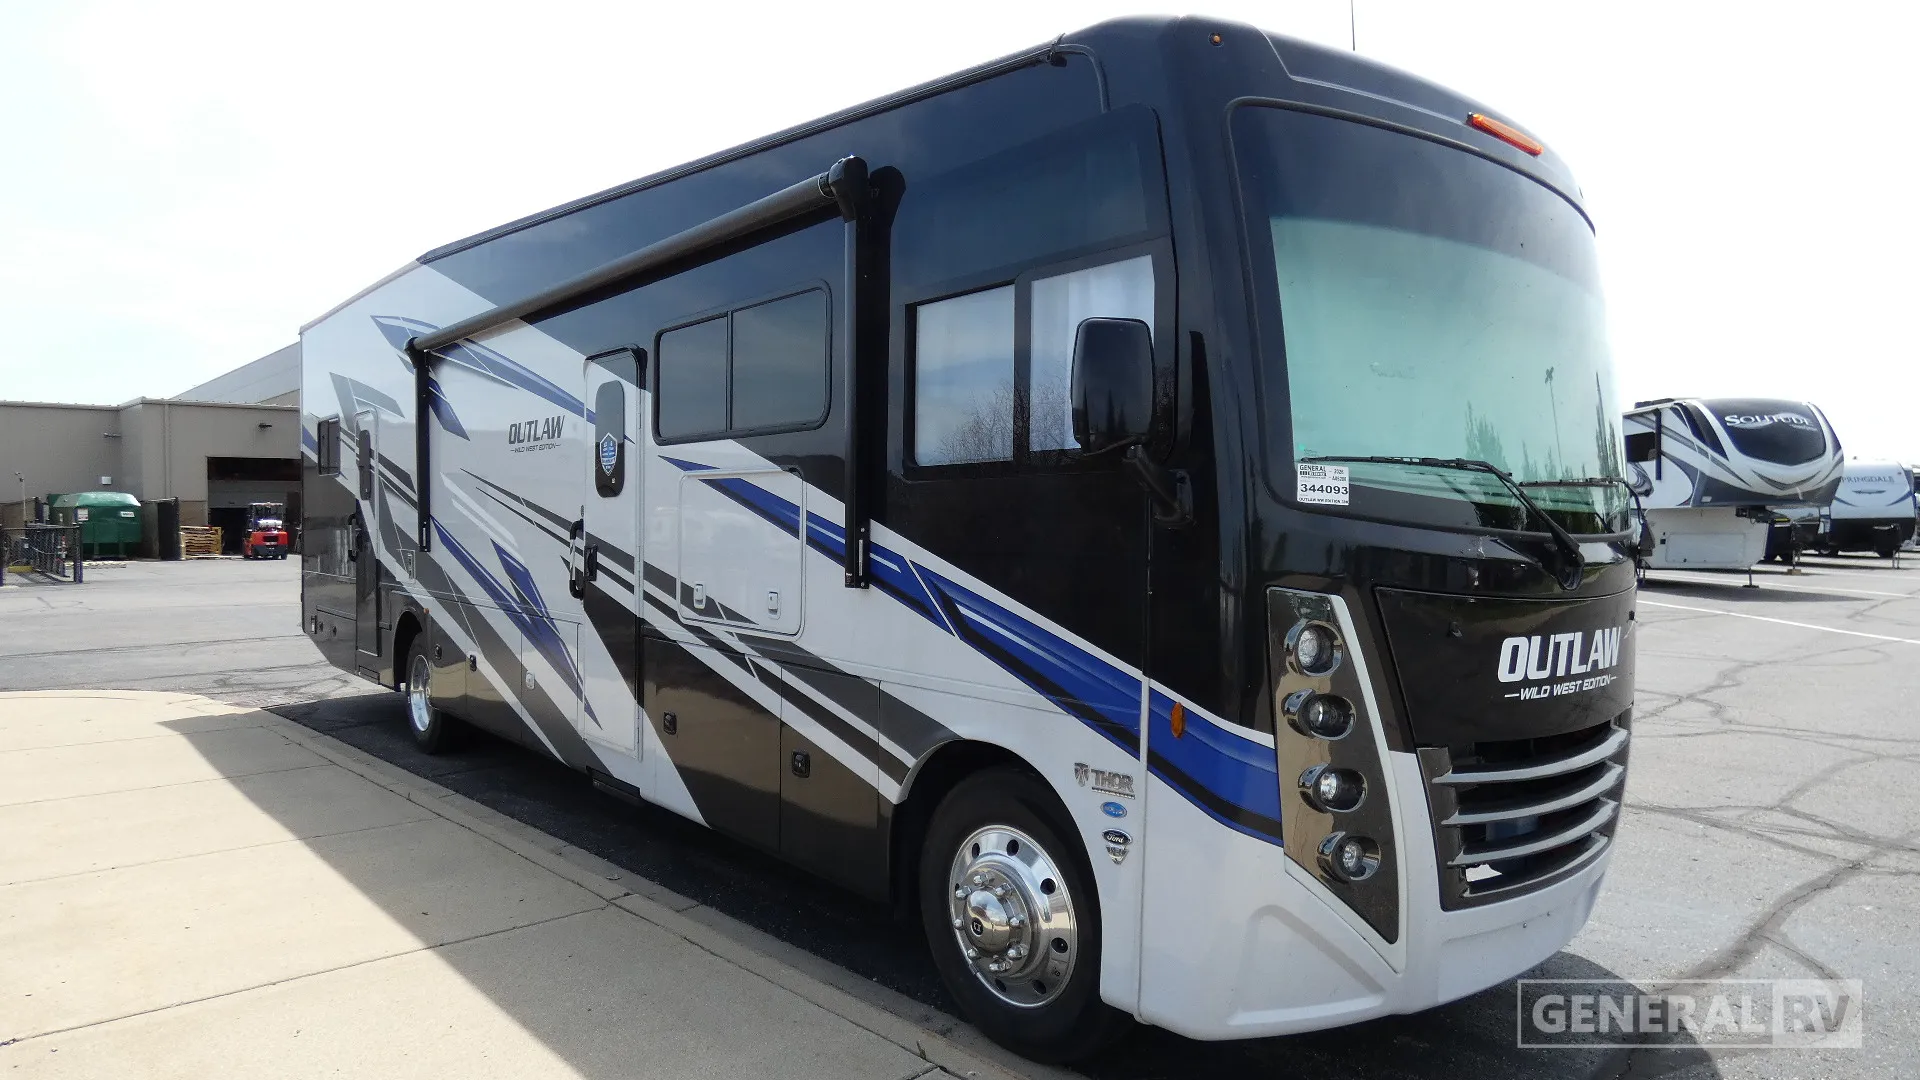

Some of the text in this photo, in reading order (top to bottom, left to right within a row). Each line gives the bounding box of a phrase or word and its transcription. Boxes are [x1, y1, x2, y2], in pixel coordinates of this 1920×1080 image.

[1724, 414, 1814, 427] SOLITUDE
[508, 415, 566, 445] OUTLAW
[526, 444, 539, 452] WEST
[538, 442, 556, 451] EDITION
[1841, 475, 1895, 483] PRINGDALE
[1300, 483, 1348, 494] 344093
[1497, 626, 1622, 683] OUTLAW
[1520, 674, 1611, 701] WILD WEST EDITION
[1091, 769, 1135, 793] THOR
[1106, 833, 1124, 843] Ford
